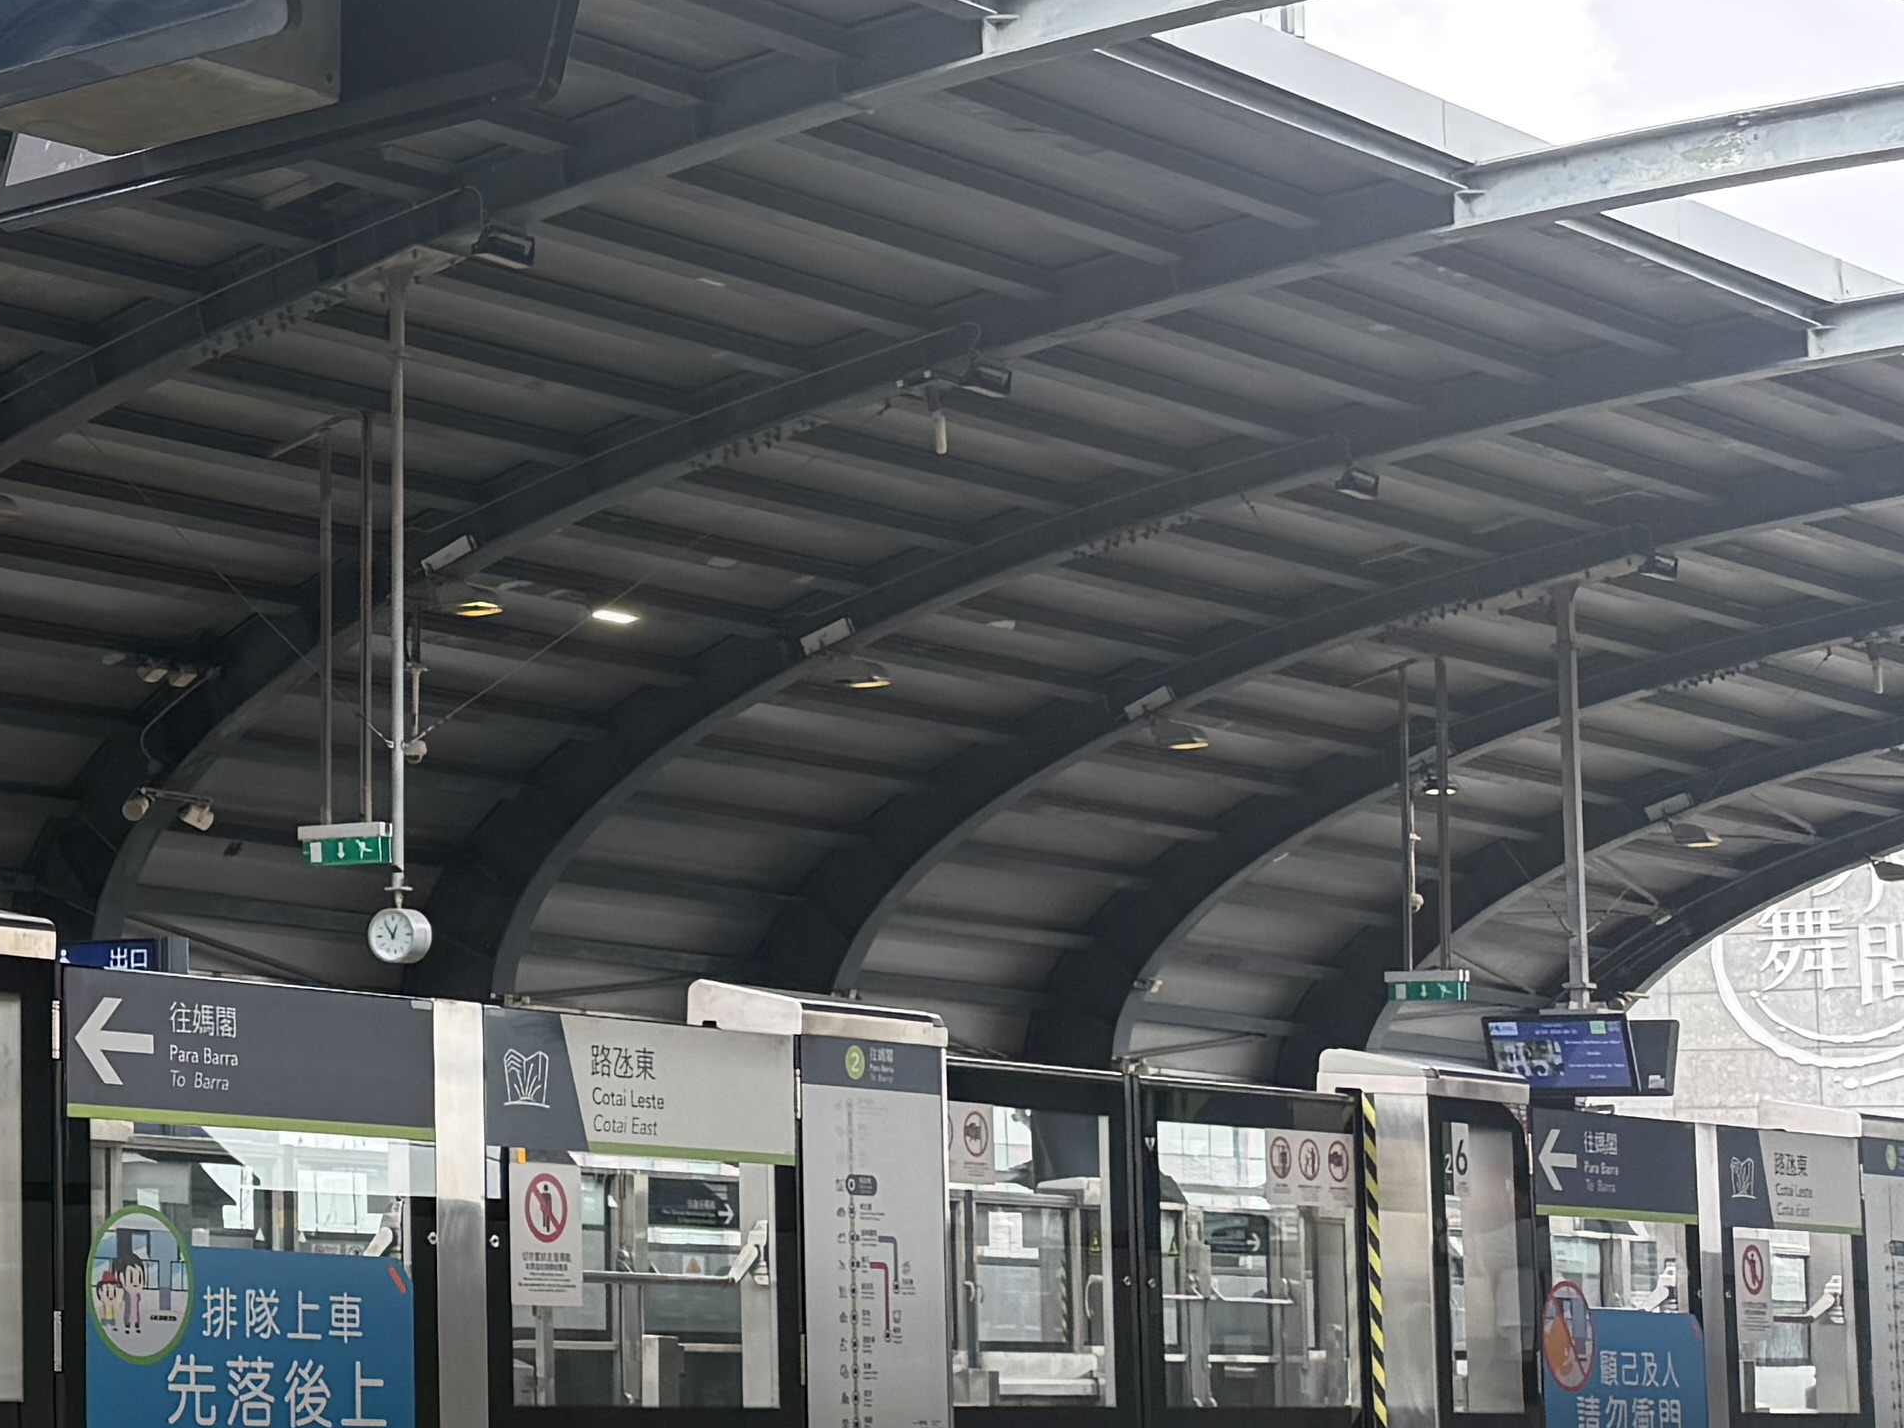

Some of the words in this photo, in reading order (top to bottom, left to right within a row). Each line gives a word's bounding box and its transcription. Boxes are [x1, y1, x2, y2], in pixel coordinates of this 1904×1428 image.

[109, 947, 148, 969] 出口
[169, 1001, 237, 1038] 往媽閣
[169, 1044, 199, 1063] Para
[203, 1047, 239, 1067] Barra
[591, 1044, 656, 1081] 路氹東
[170, 1069, 186, 1087] To
[194, 1072, 229, 1091] Barra
[592, 1086, 627, 1107] Cotai
[630, 1089, 665, 1110] Leste
[593, 1113, 628, 1133] Cotai
[631, 1116, 658, 1136] East
[1444, 1153, 1453, 1174] 2
[1455, 1139, 1468, 1176] 6
[202, 1285, 364, 1344] 排隊上車
[167, 1353, 388, 1428] 先落後上
